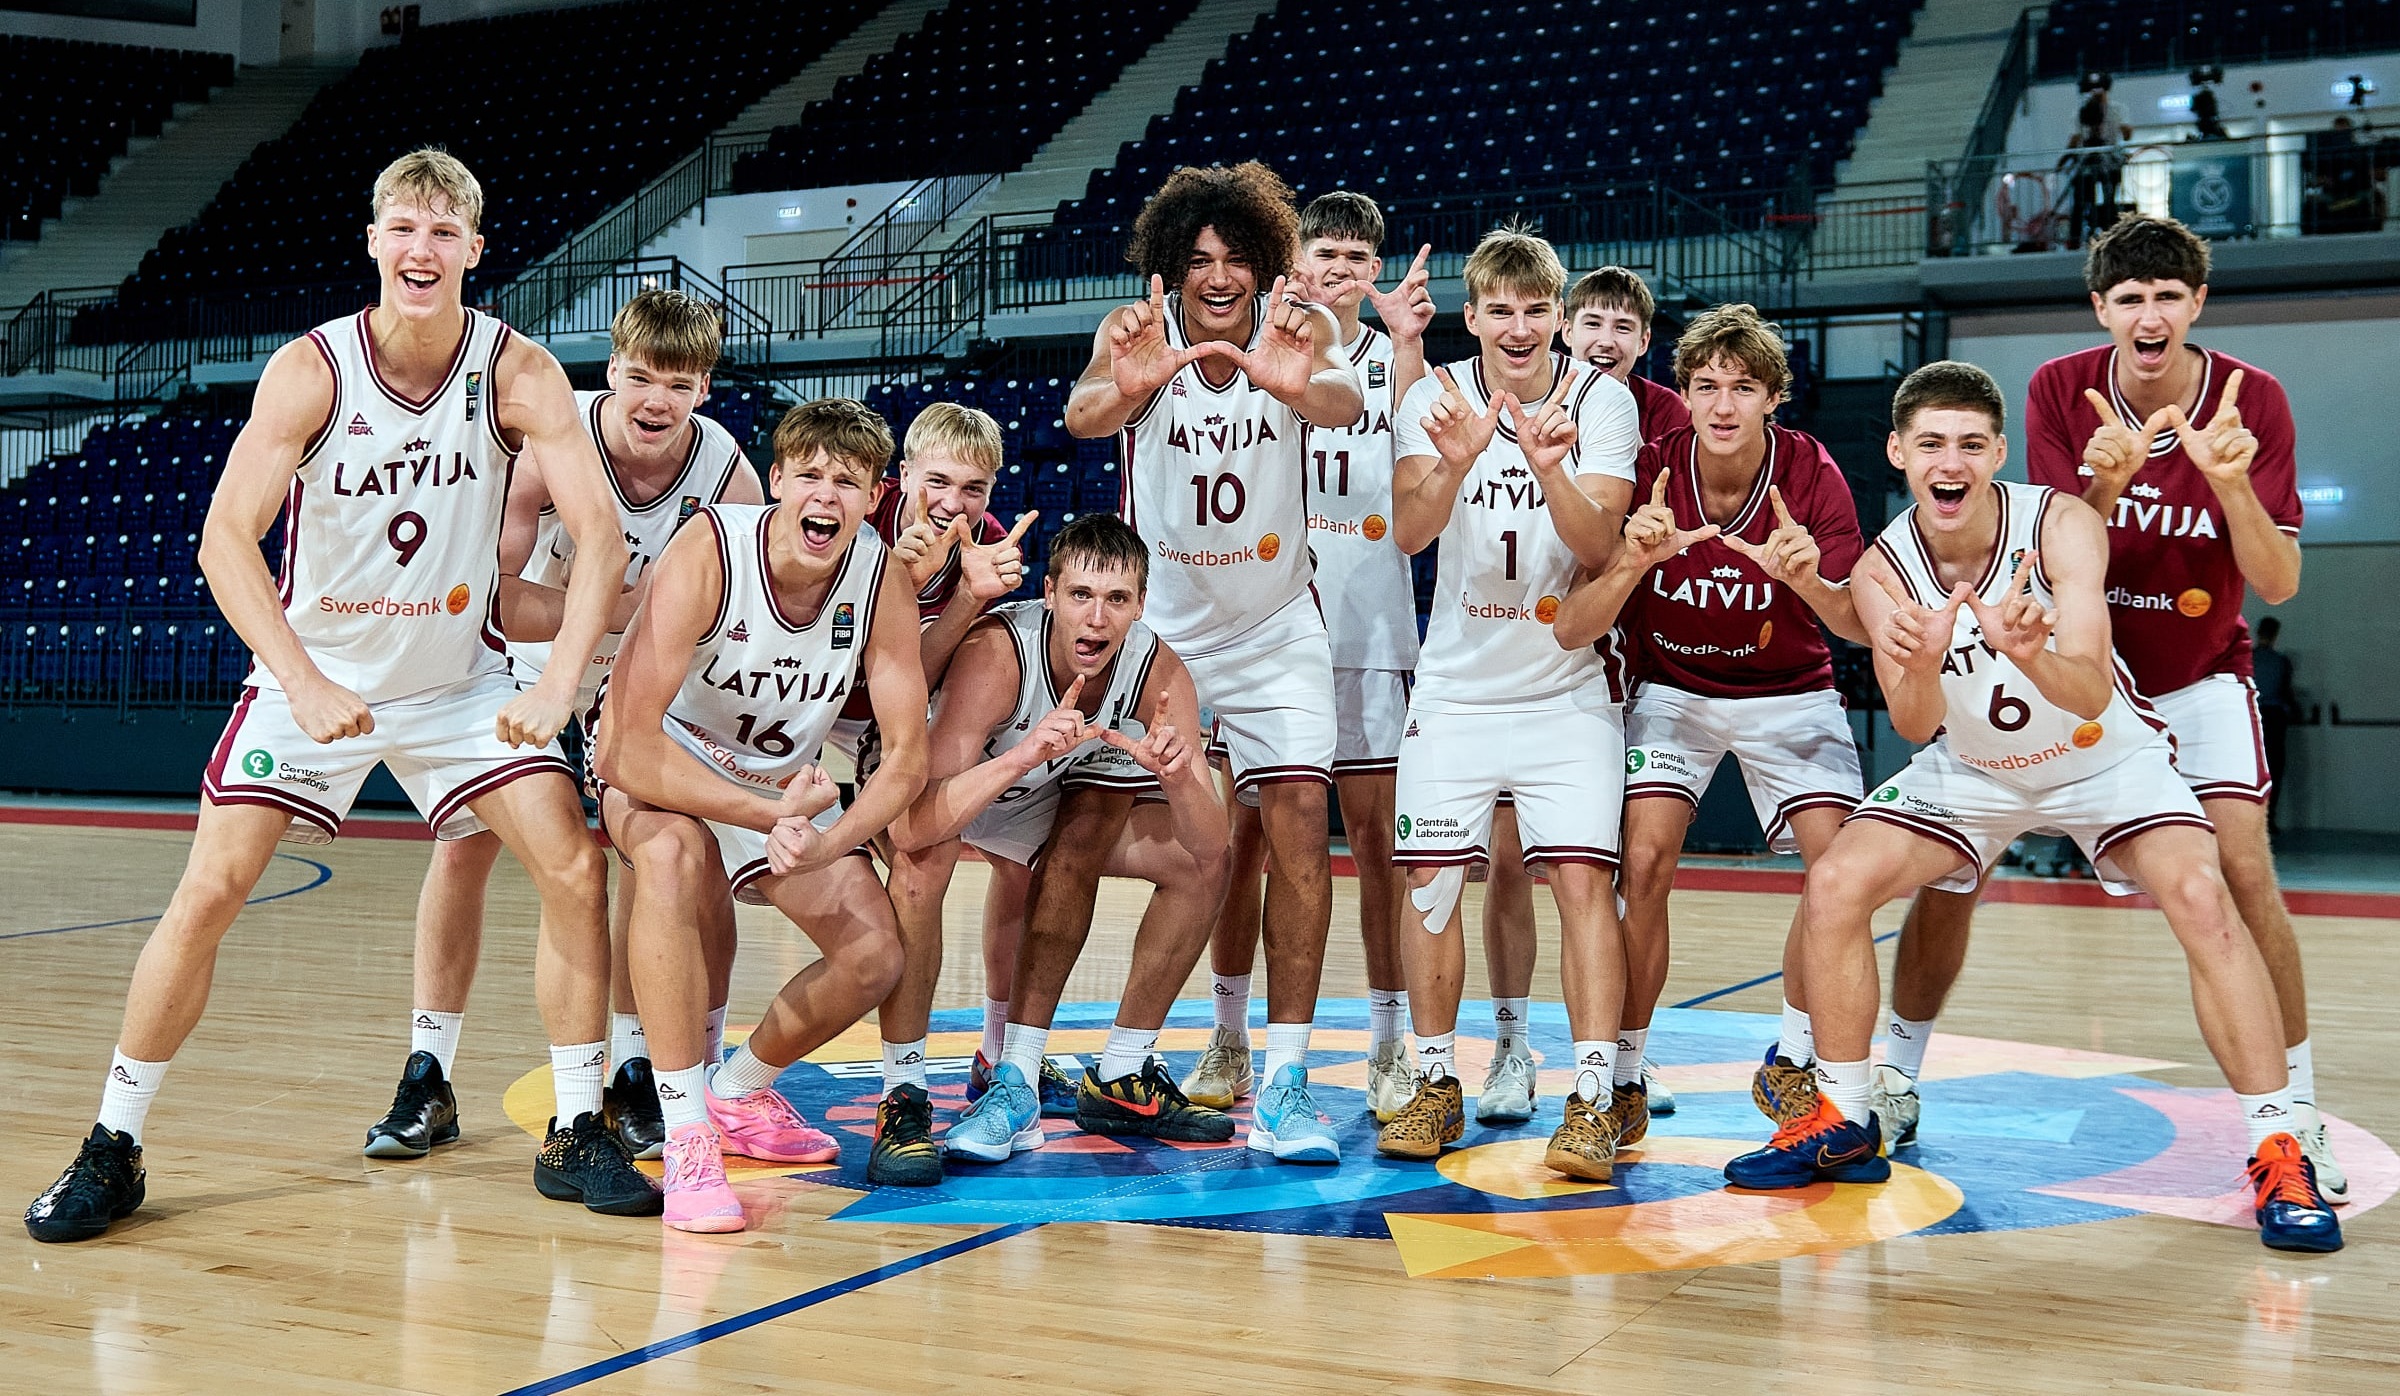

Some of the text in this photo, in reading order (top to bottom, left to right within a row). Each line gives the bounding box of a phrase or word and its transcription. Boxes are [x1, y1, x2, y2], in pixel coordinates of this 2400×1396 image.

[1172, 387, 1188, 398] EAK
[348, 425, 375, 436] PEAK
[1167, 414, 1278, 456] LATVIJA
[334, 452, 478, 497] LATVIJA
[1312, 450, 1350, 497] 11
[1190, 472, 1246, 527] 10
[2106, 496, 2218, 539] TVIJA
[387, 511, 428, 568] 9
[1307, 513, 1359, 535] dbank
[1157, 541, 1254, 567] Swedbank
[1500, 530, 1517, 581] 1
[320, 596, 441, 617] Swedbank
[1653, 569, 1773, 611] LATVIJ
[2105, 586, 2174, 611] dbank
[834, 629, 851, 638] FIBA
[702, 654, 846, 703] LATVIJA
[1988, 683, 2032, 732] 6
[680, 722, 776, 787] Swedbank
[736, 713, 796, 758] 16
[1959, 742, 2071, 770] Swedbank
[1580, 1059, 1609, 1068] PEAK
